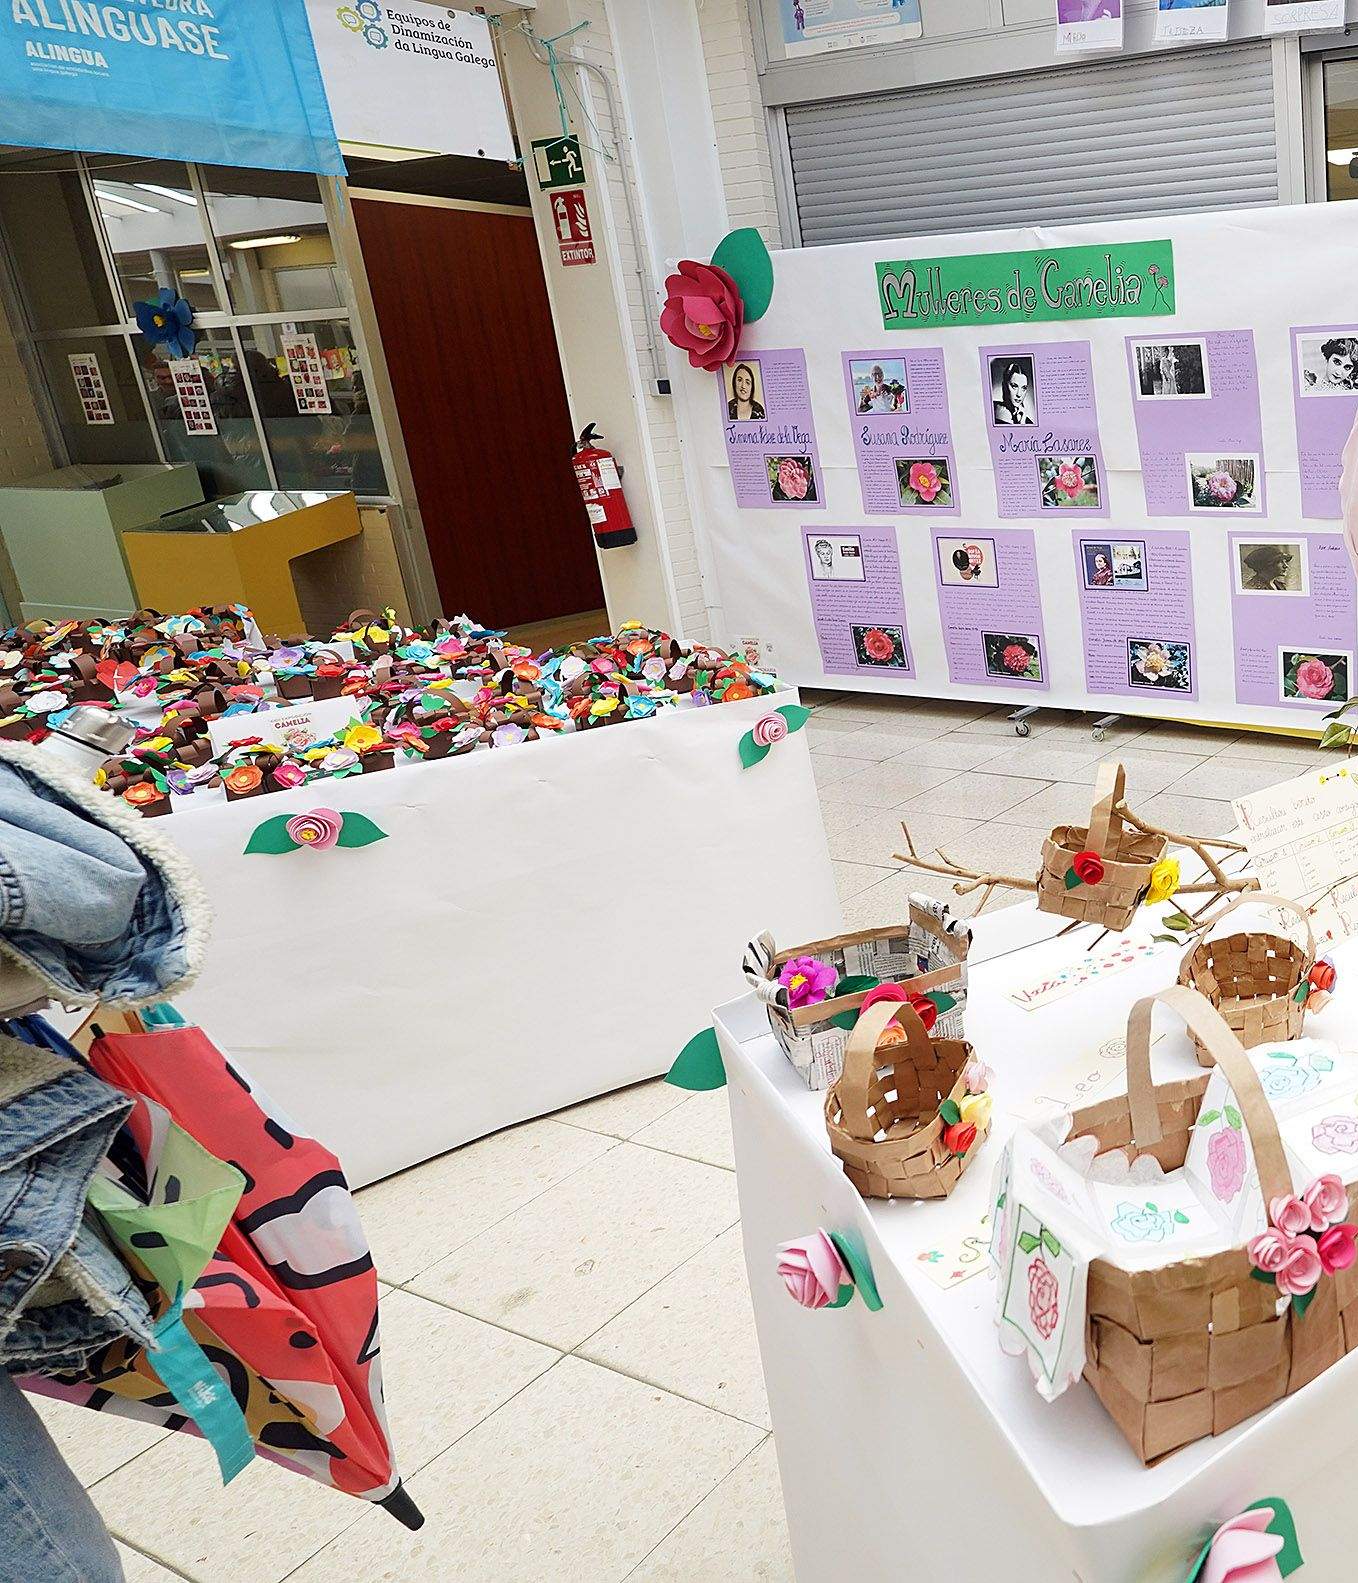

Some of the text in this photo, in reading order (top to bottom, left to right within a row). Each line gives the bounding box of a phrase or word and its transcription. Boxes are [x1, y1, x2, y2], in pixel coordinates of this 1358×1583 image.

[12, 0, 230, 61] ALINGUASE
[386, 9, 452, 32] Equipos de
[391, 23, 473, 50] Dinamización
[25, 40, 109, 69] ALINGUA
[394, 39, 496, 68] da Lingua Galega
[562, 248, 594, 261] EXTINTOR
[882, 267, 1001, 321] Mulleres
[1007, 269, 1038, 310] de
[274, 717, 311, 729] CAMELIA
